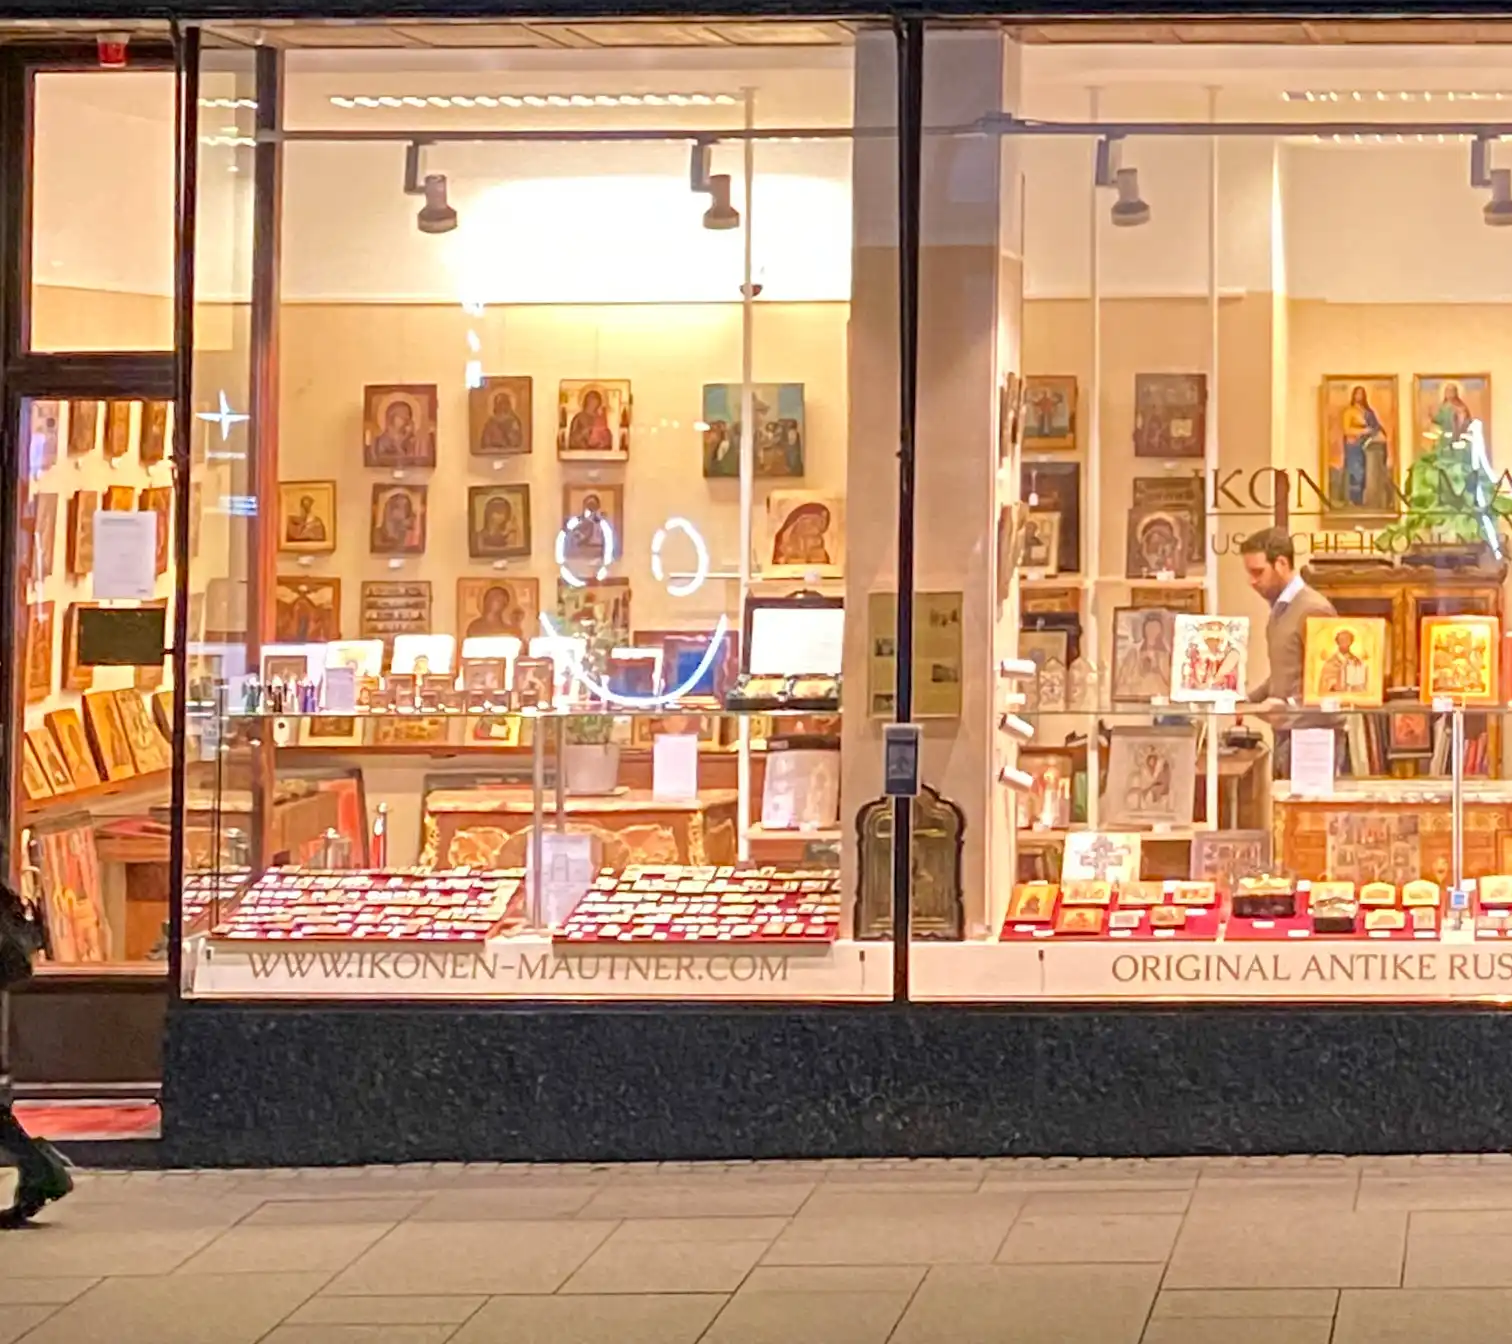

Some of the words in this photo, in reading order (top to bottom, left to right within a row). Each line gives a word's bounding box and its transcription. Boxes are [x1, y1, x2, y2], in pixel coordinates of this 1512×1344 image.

[1191, 467, 1413, 509] KONN
[1190, 530, 1346, 556] USCHE
[248, 951, 790, 981] WWW.IKONEN-MAUTNER.COM
[1111, 954, 1291, 982] ORIGINAL
[1300, 953, 1437, 982] ANTIKE
